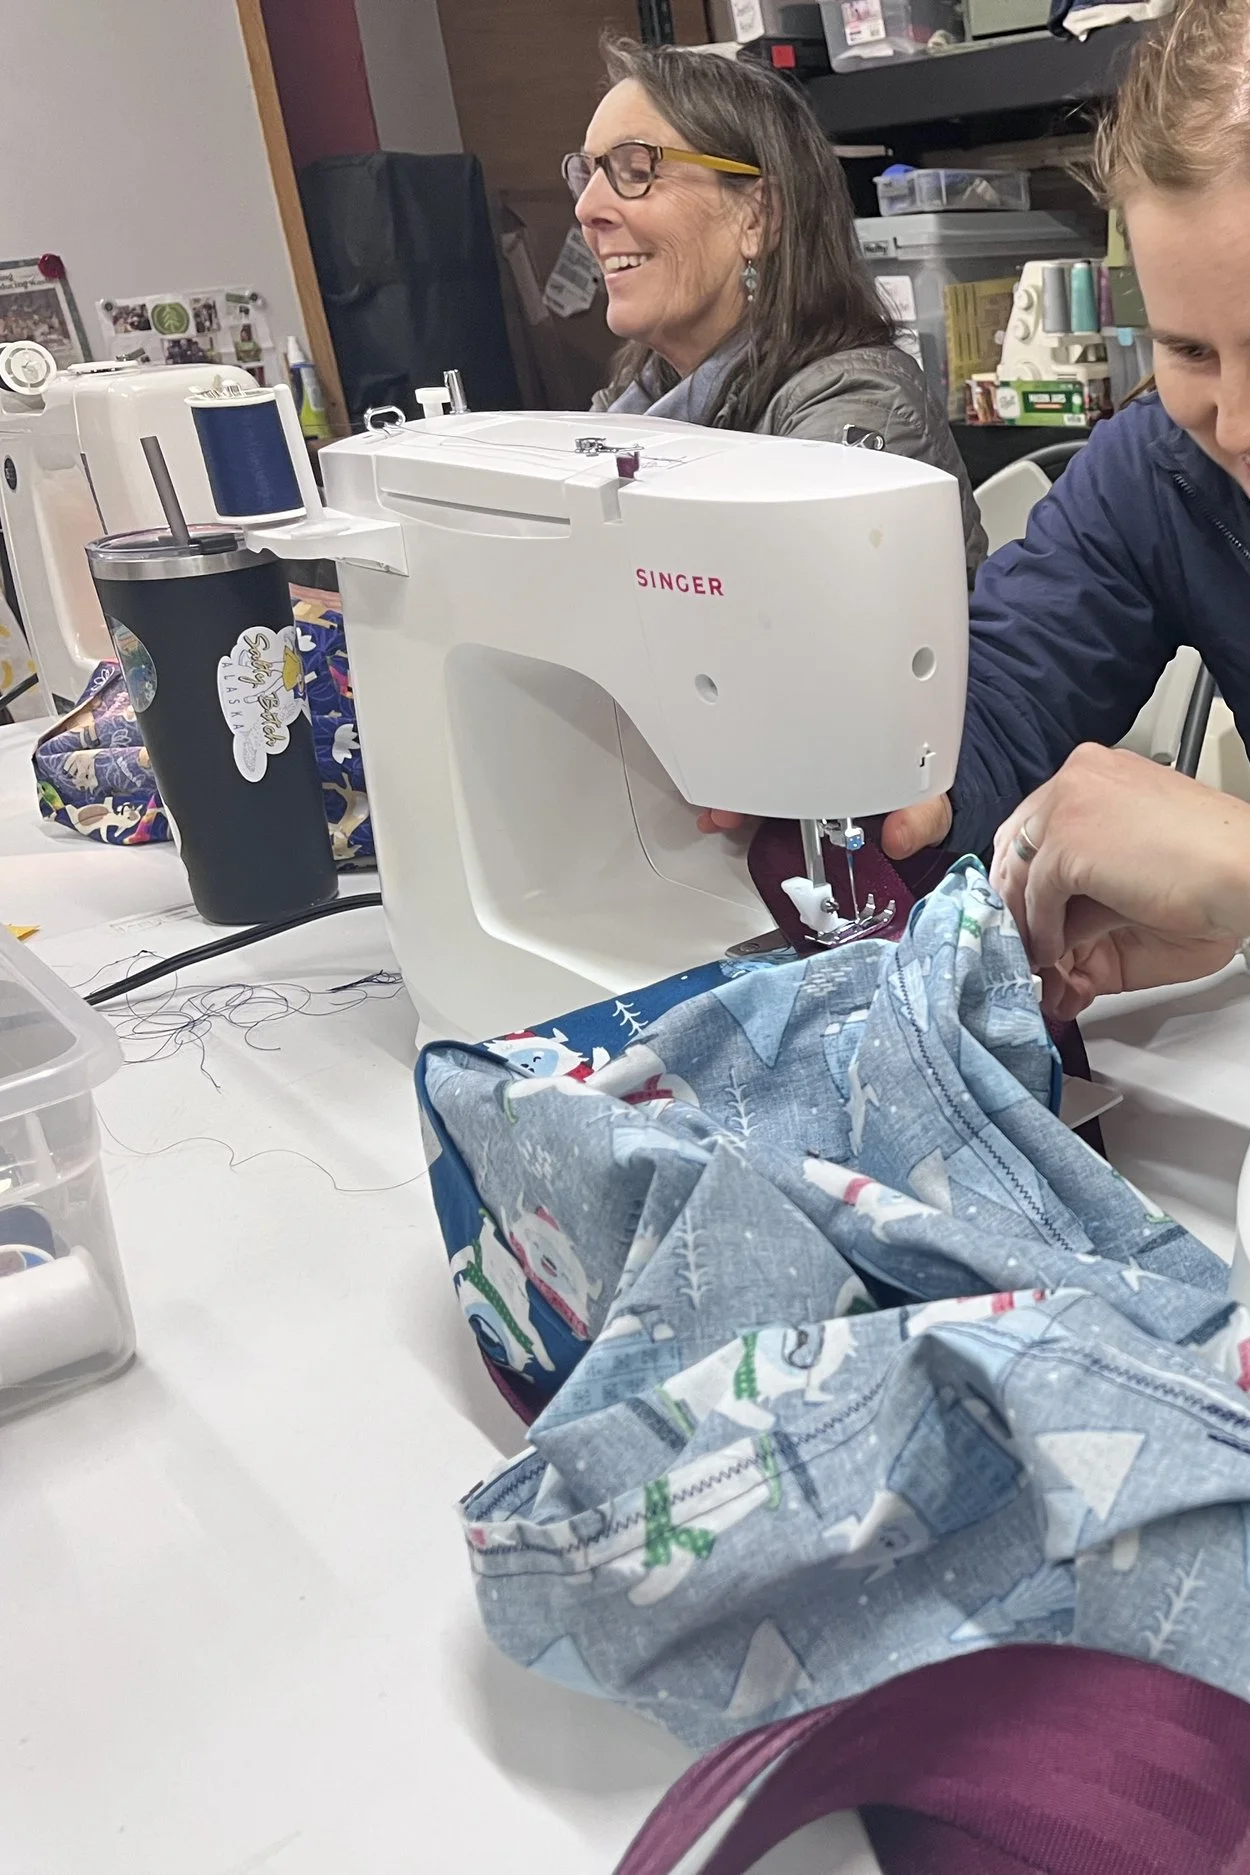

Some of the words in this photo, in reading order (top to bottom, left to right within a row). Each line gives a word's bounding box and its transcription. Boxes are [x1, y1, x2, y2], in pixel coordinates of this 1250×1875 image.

[636, 567, 725, 596] SINGER
[221, 661, 245, 731] ALASKA
[238, 632, 273, 689] Salty
[257, 691, 287, 748] Bitch
